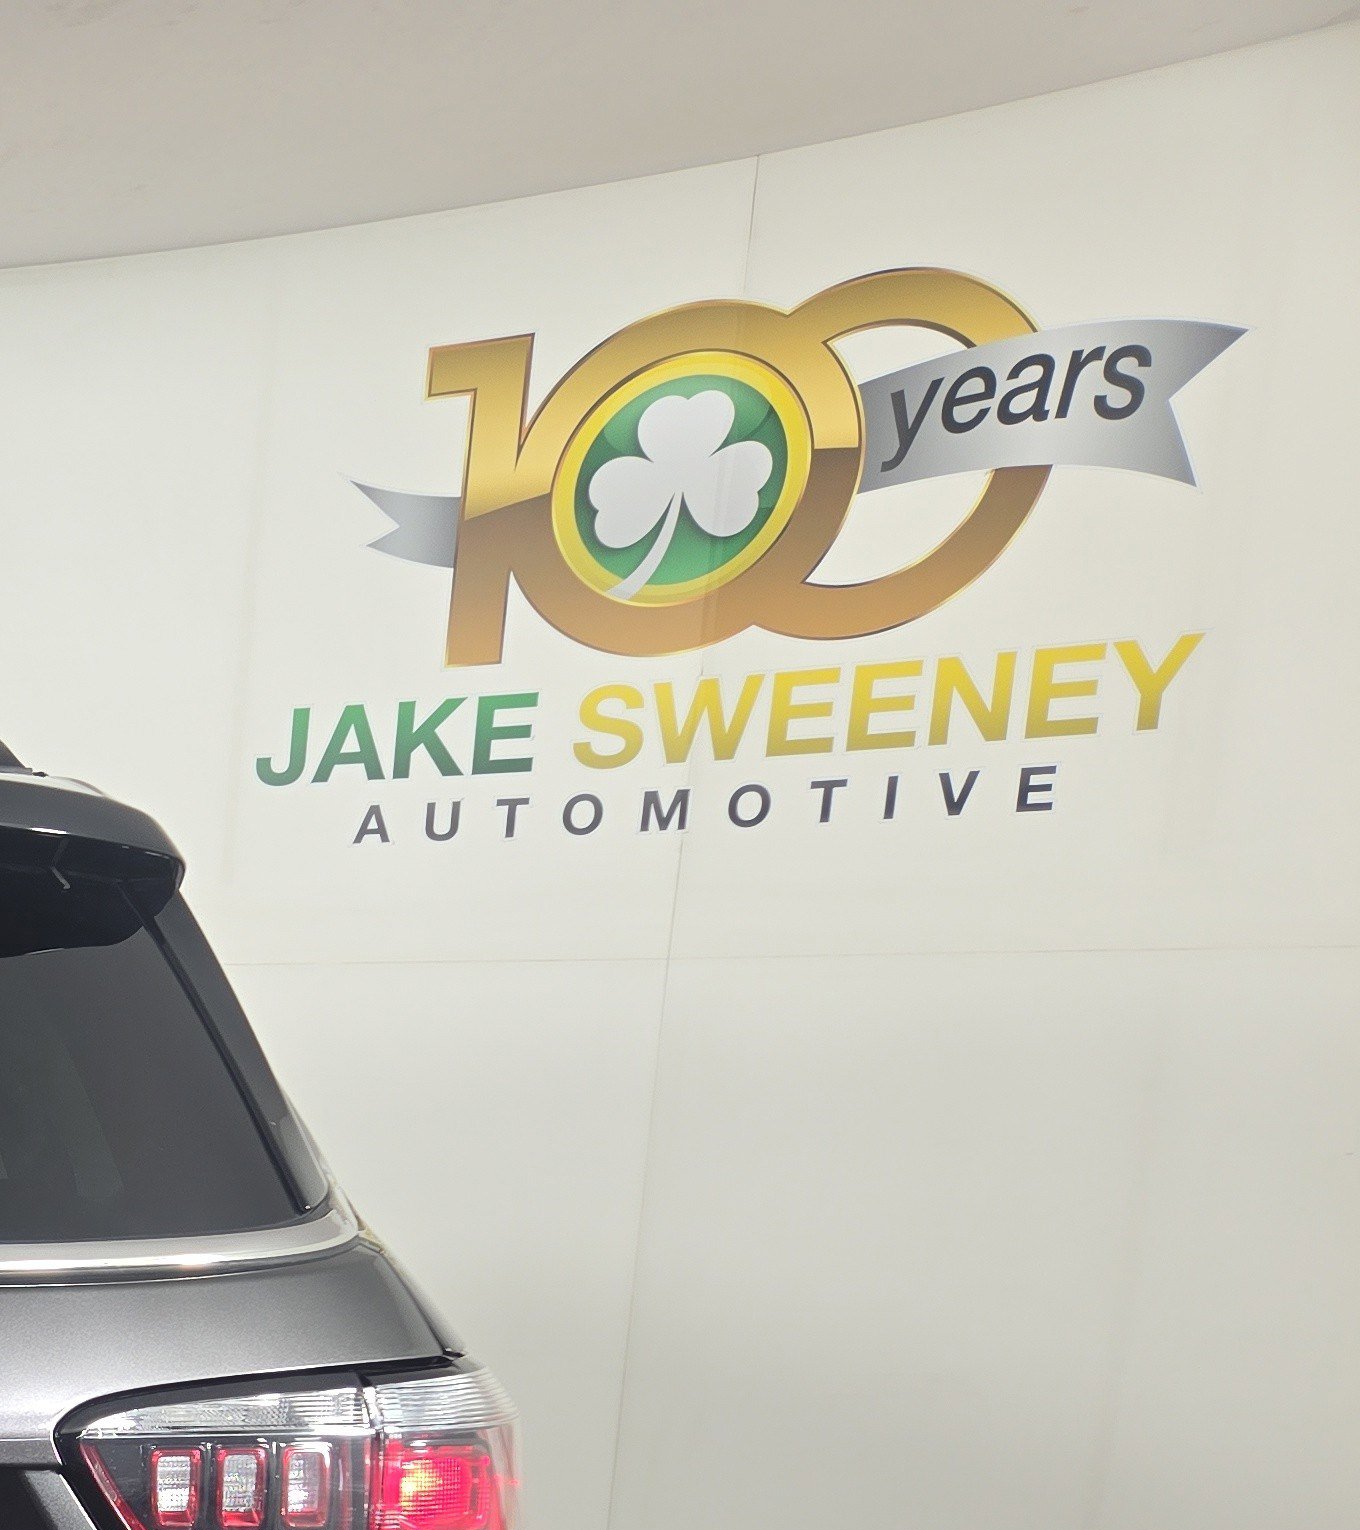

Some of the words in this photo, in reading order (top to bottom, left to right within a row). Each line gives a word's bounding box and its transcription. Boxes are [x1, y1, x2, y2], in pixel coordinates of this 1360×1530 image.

[425, 266, 1052, 667] 100
[880, 341, 1151, 473] years
[256, 691, 540, 787] JAKE
[572, 632, 1206, 769] SWEENEY
[352, 764, 1057, 846] AUTOMOTIVE
